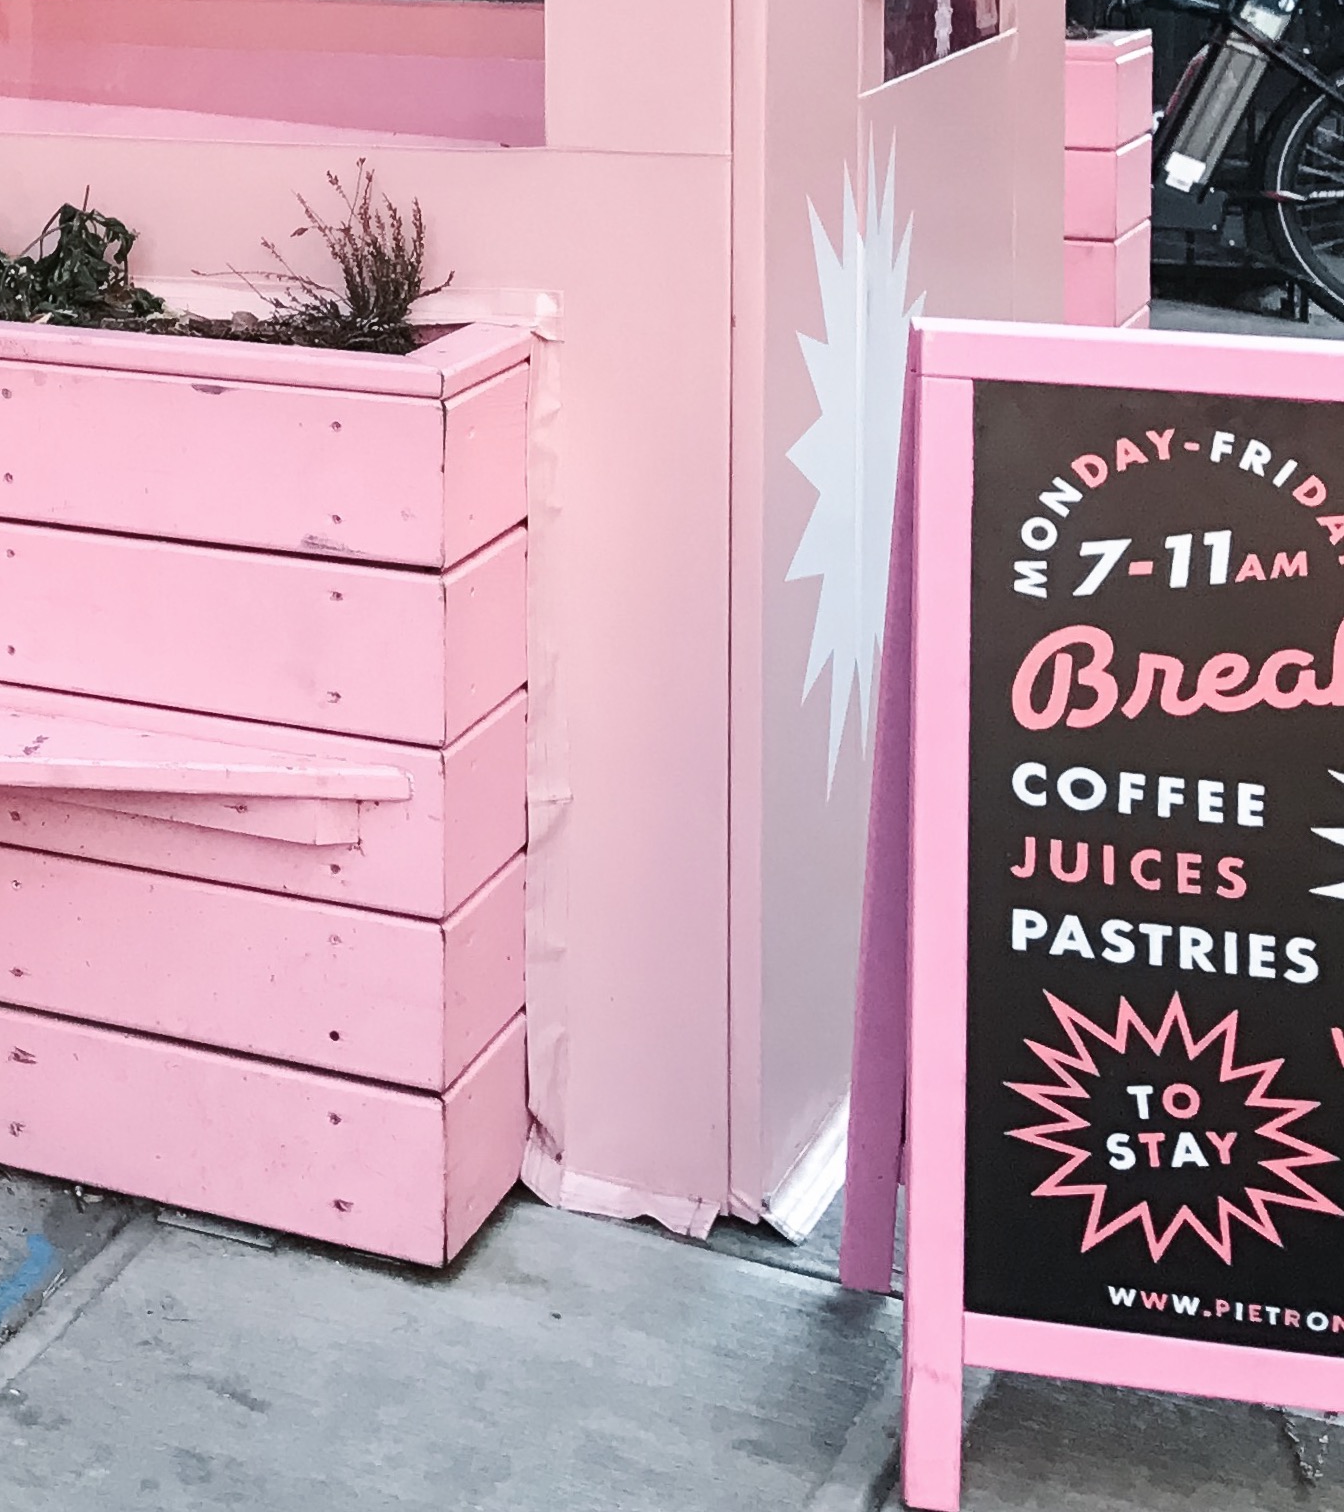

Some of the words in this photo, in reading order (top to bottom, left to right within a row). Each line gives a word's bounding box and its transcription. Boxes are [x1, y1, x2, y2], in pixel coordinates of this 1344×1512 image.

[1013, 428, 1344, 599] MONDAY-FRIDA
[1012, 762, 1266, 828] COFFEE
[1011, 836, 1248, 900] JUICES
[1012, 908, 1320, 984] PASTRIES
[1126, 1082, 1201, 1120] TO
[1106, 1131, 1238, 1171] STAY
